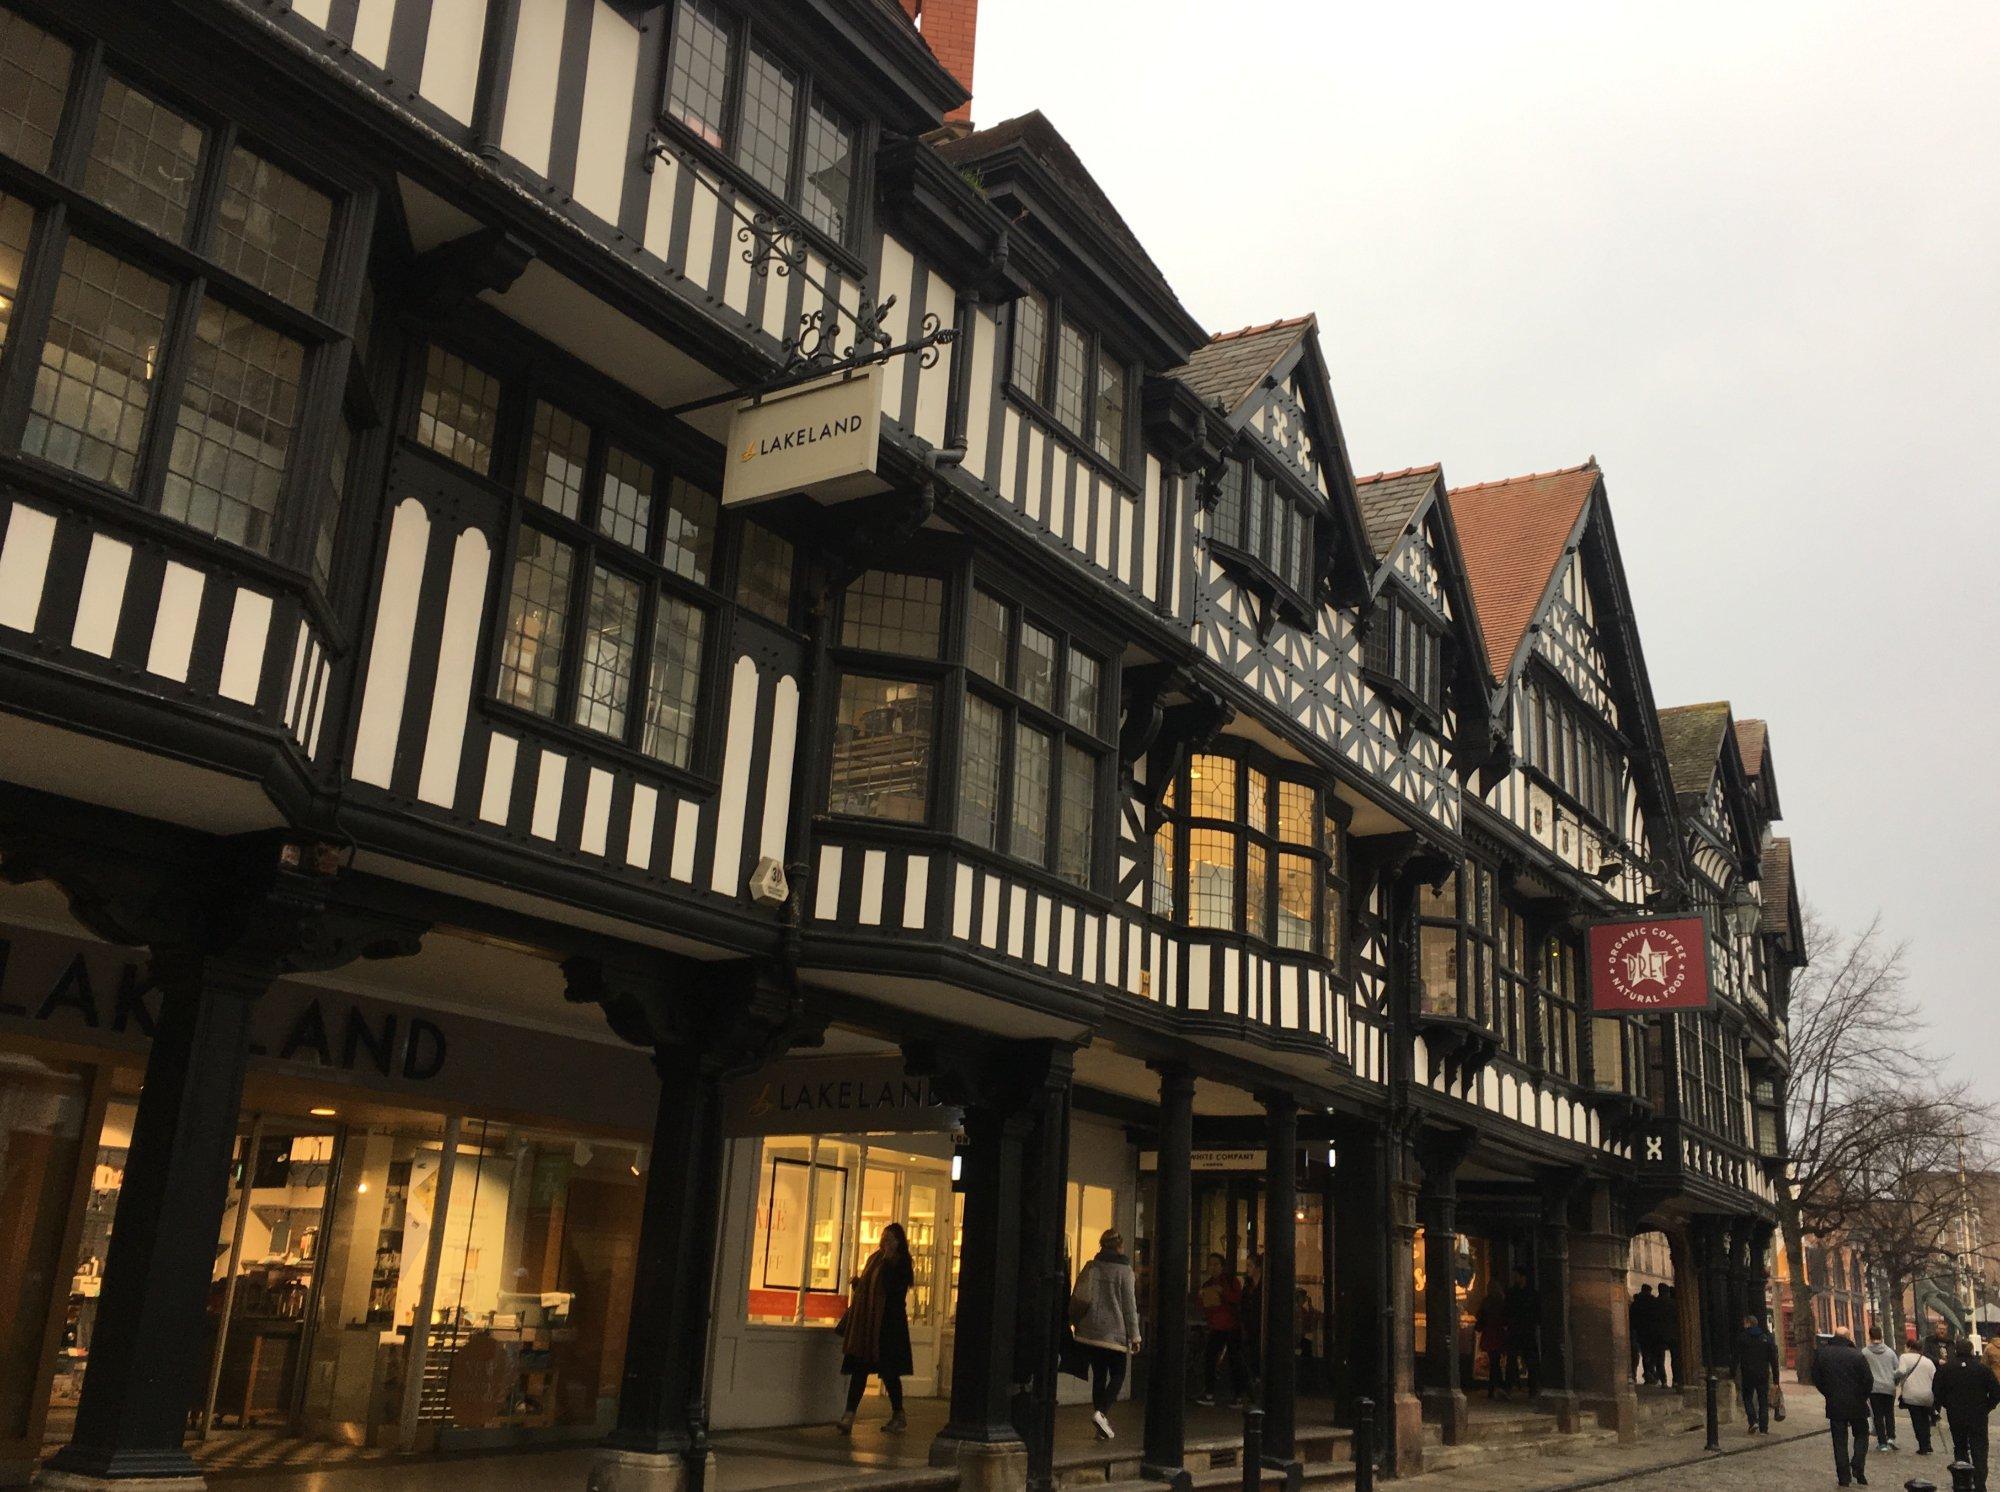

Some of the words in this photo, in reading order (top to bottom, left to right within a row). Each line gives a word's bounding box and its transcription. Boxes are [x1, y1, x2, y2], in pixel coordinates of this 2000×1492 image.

[760, 415, 862, 456] LAKELAND
[1608, 927, 1647, 964] ORGANIC
[1652, 928, 1687, 959] COFFEE
[1627, 952, 1668, 980] PRET
[1612, 977, 1661, 1003] NATURAL
[1662, 973, 1686, 998] FOOD
